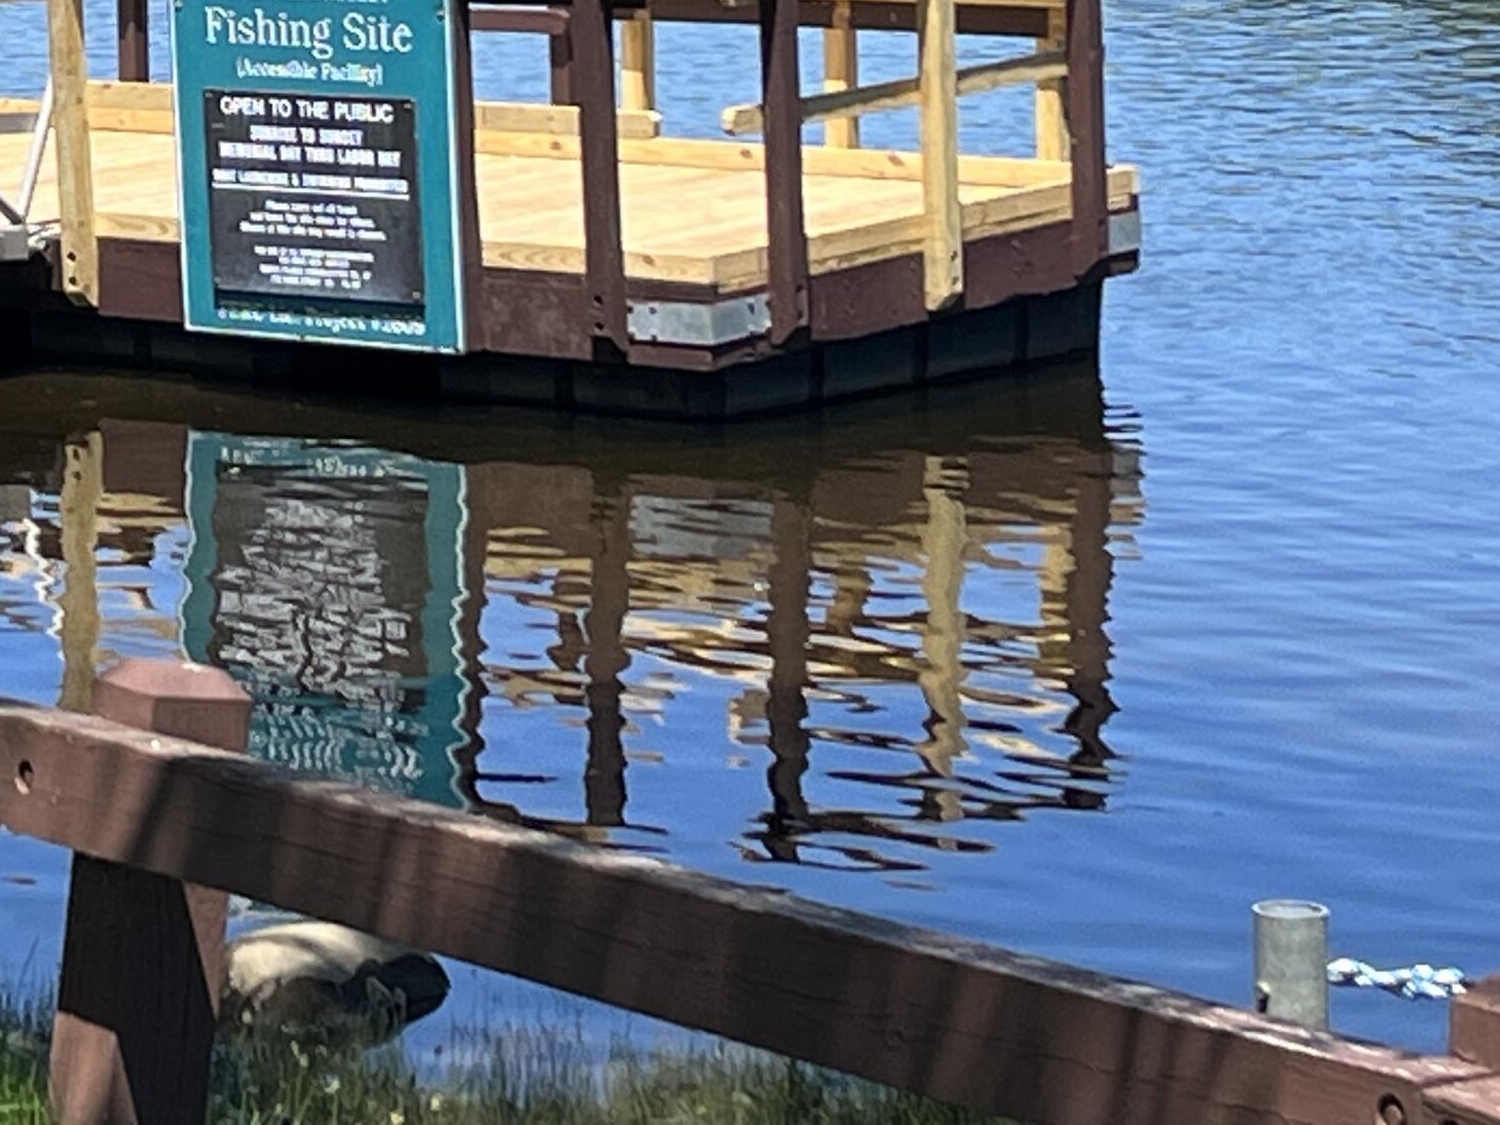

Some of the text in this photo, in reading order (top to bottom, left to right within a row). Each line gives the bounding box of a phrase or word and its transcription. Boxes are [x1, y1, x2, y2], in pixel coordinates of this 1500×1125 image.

[204, 5, 414, 59] Fishing Site
[220, 96, 394, 123] OPEN TO THE PUBLIC
